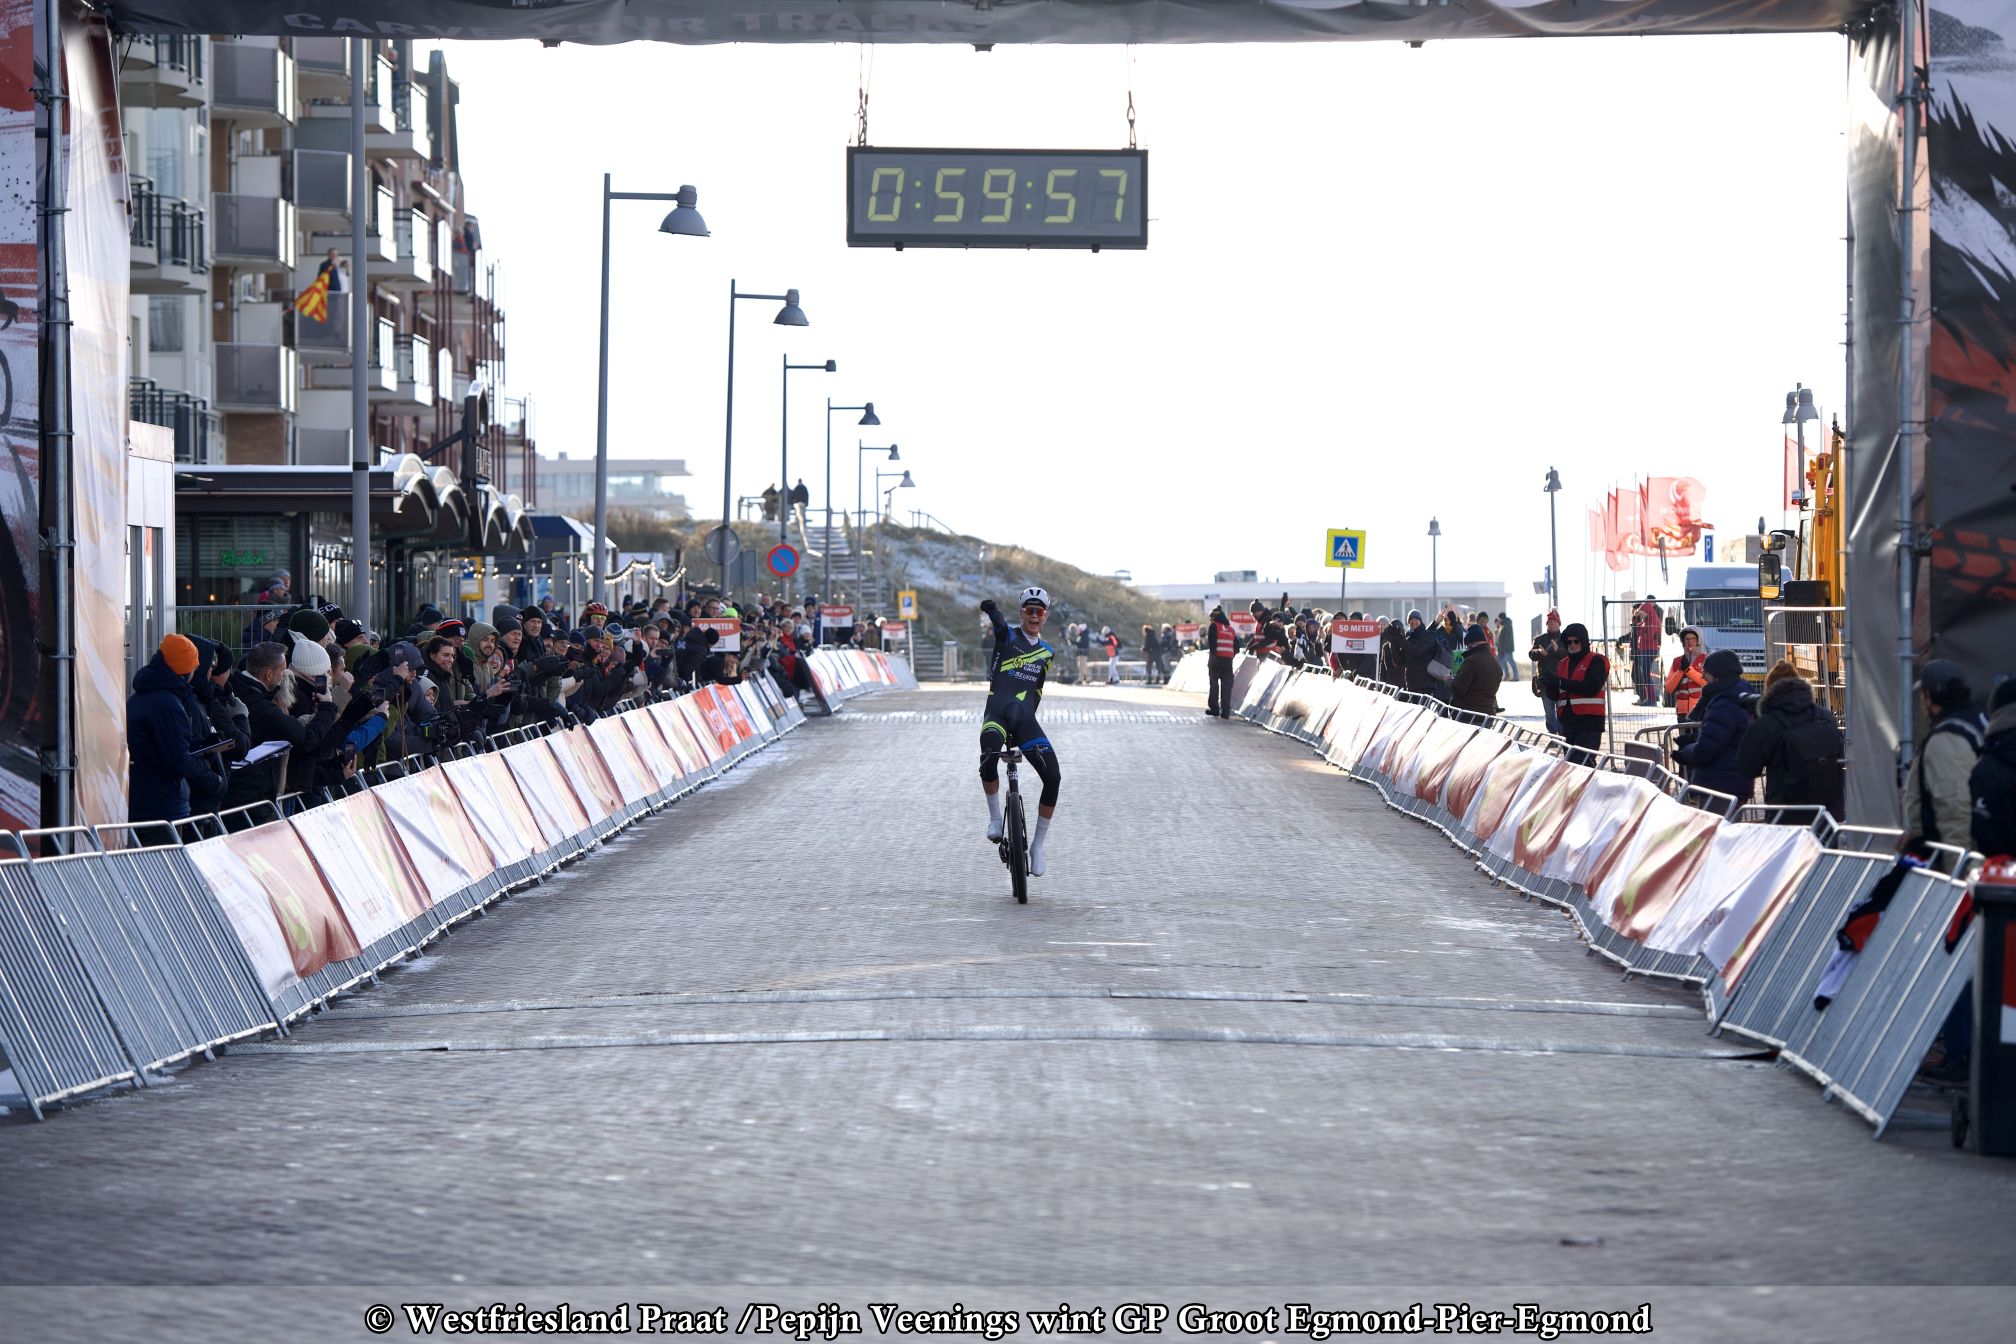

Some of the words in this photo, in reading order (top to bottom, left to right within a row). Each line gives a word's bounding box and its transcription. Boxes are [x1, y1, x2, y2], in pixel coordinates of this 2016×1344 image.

[283, 13, 504, 36] CARVE
[529, 16, 708, 36] YOUR
[868, 167, 1129, 224] 0:59:57
[698, 623, 709, 631] 50
[710, 623, 734, 631] METER
[1339, 624, 1349, 632] 50
[1350, 624, 1374, 632] METER
